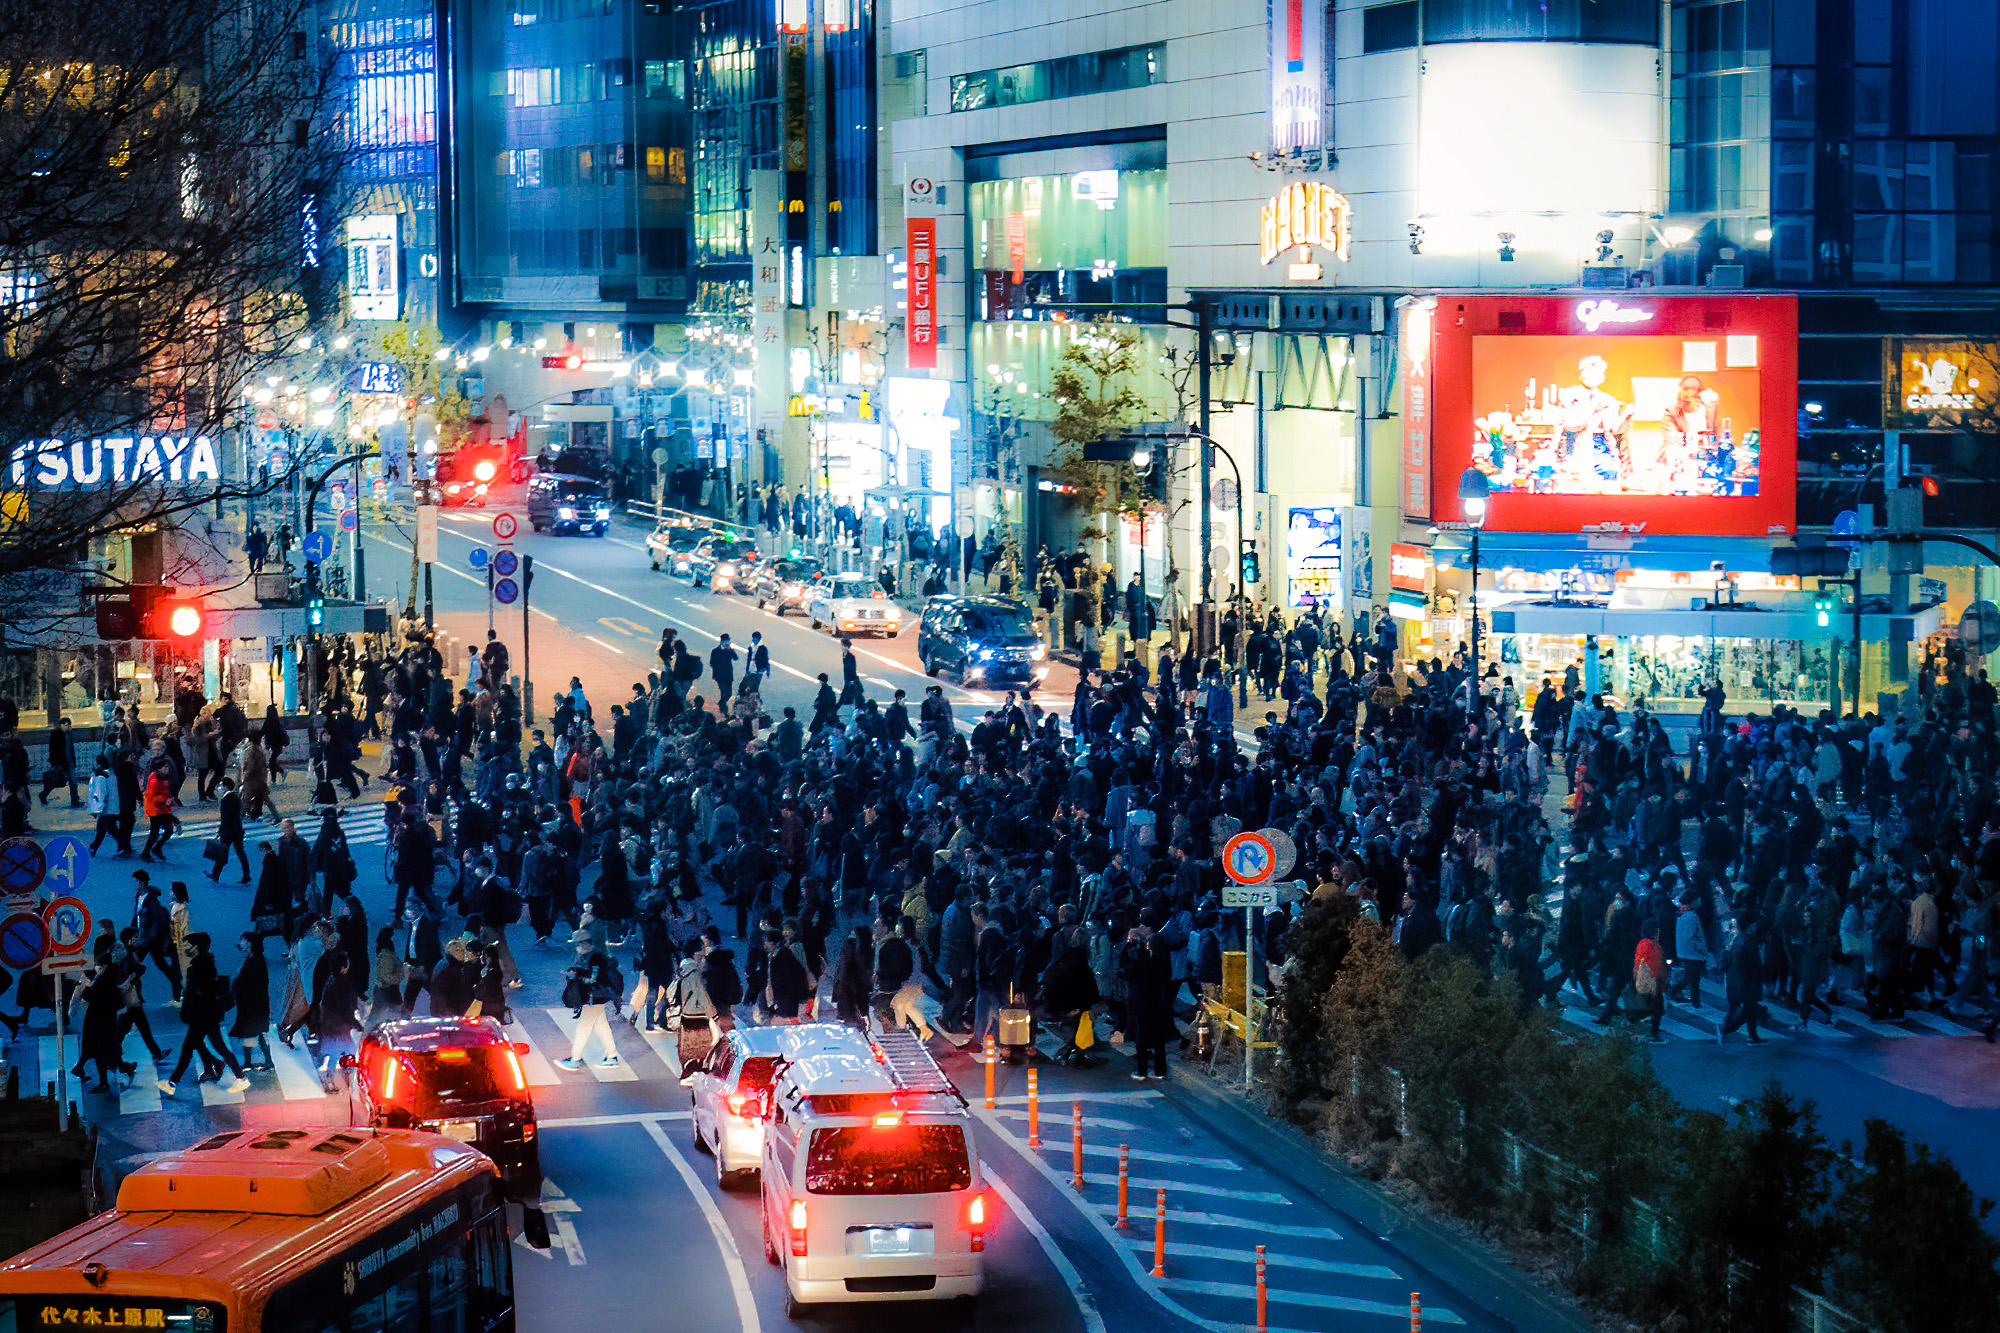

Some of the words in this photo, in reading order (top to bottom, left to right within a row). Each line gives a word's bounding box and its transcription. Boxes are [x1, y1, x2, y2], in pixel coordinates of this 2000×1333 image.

[1906, 393, 1975, 409] COFFEE
[11, 436, 219, 485] TSUTAYA
[1227, 890, 1272, 903] ここから
[40, 1305, 167, 1328] 代々木上原駅
